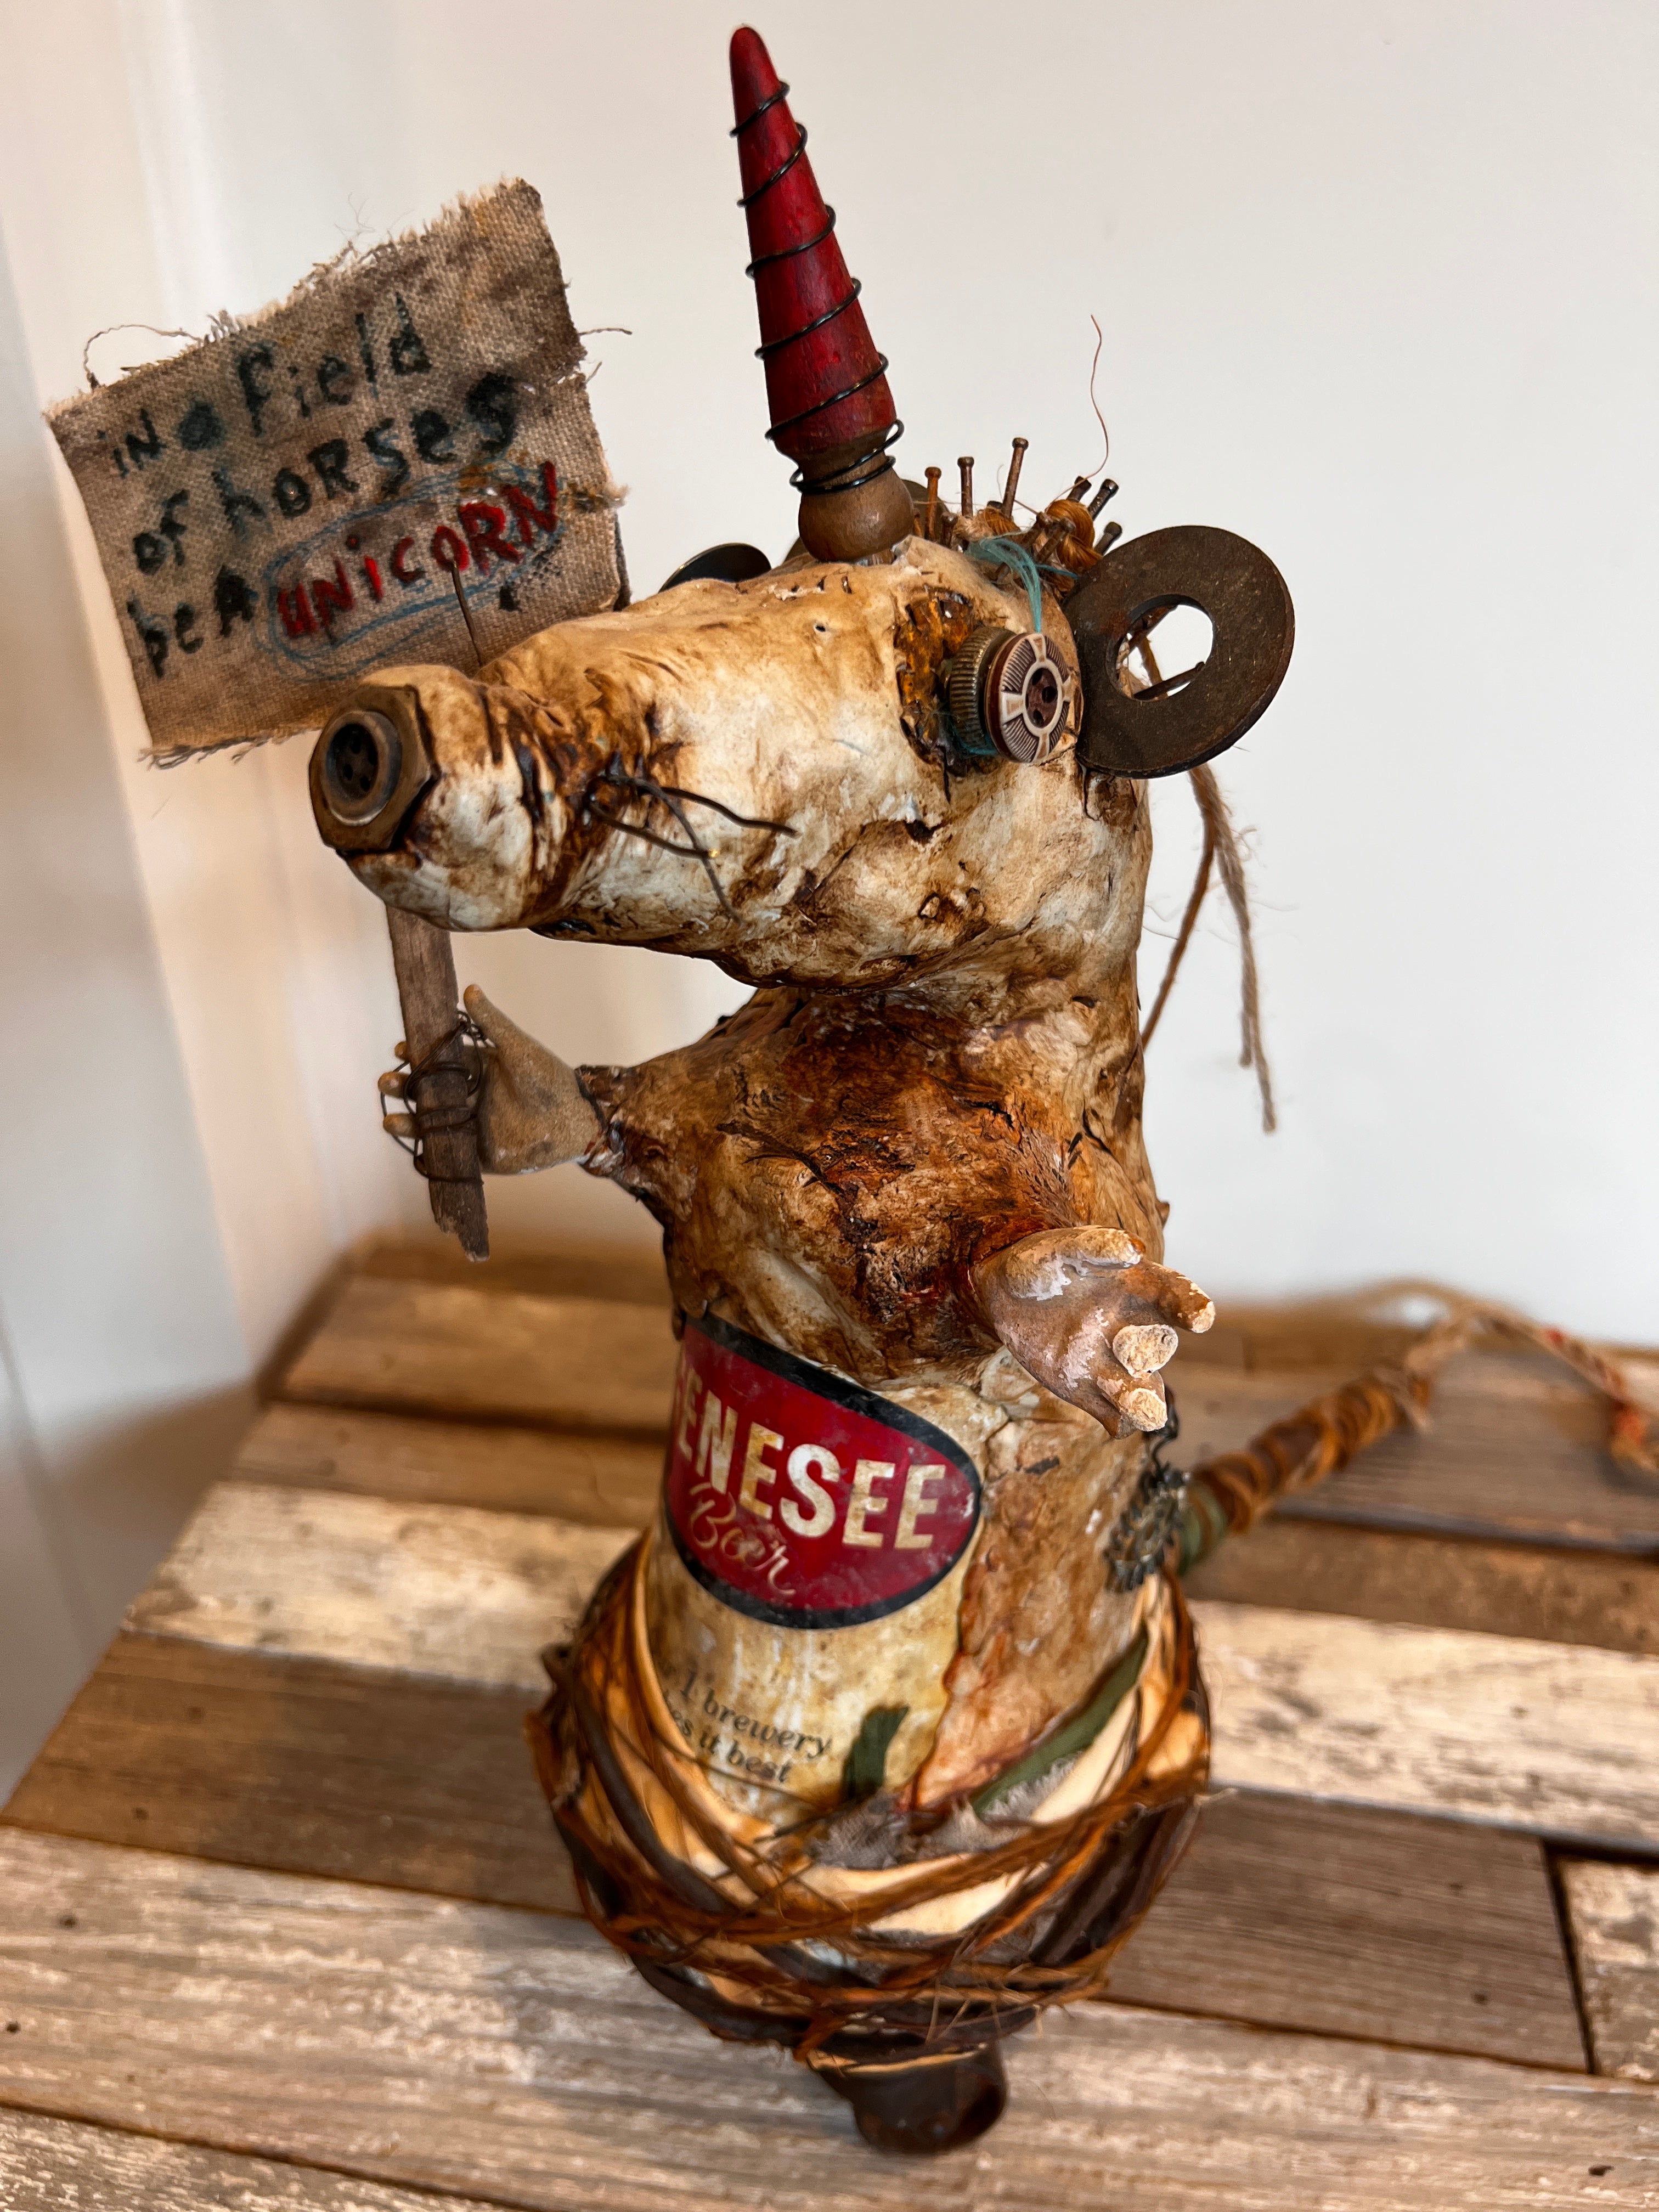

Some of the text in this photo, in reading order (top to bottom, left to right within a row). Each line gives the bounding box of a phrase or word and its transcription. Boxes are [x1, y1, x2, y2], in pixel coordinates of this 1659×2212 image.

[678, 1363, 946, 1549] ENESEE
[704, 1686, 832, 1759] brewery
[727, 1739, 792, 1784] best
